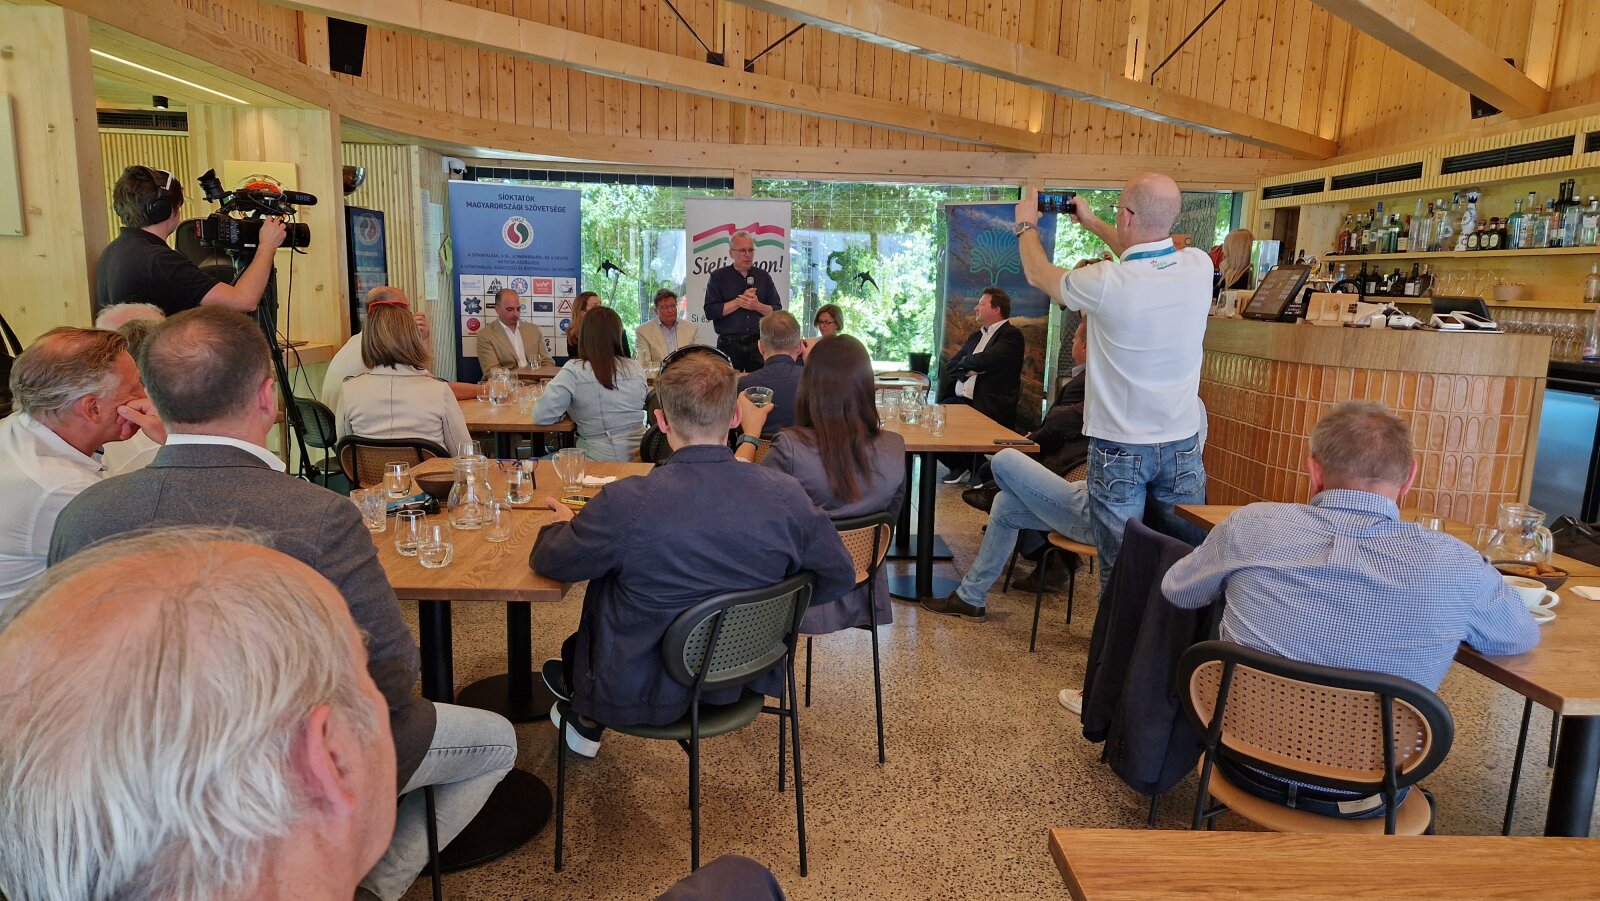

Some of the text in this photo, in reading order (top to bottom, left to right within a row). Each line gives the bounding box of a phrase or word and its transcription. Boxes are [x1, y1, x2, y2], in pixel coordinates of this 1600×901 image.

[498, 192, 535, 202] SÍOKTATÓK
[466, 201, 567, 213] MAGYARORSZÁGI SZÖVETSÉGE
